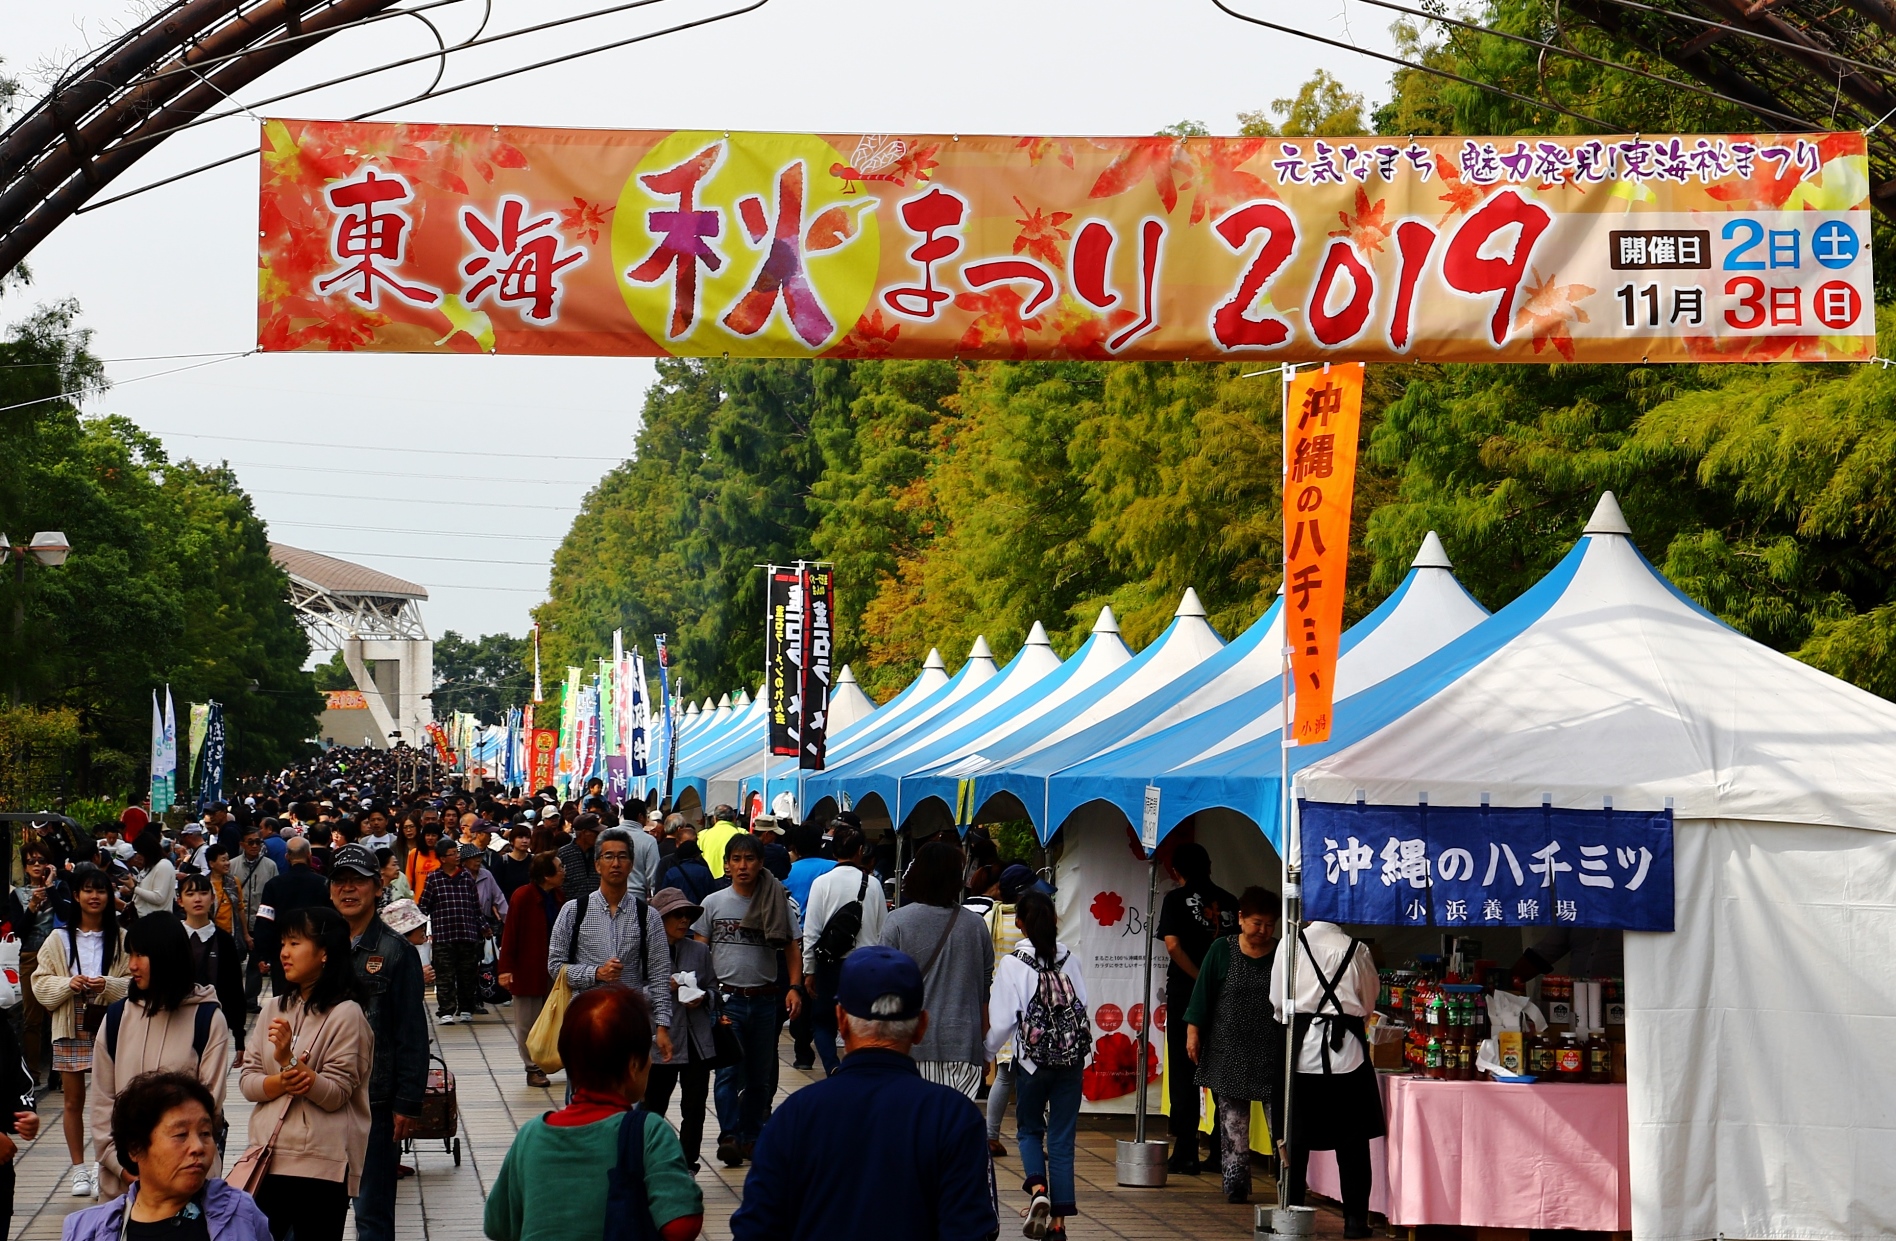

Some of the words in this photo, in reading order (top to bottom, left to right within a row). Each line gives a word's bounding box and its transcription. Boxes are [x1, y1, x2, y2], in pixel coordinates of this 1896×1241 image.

[1273, 142, 1435, 185] 元気なまち
[1619, 235, 1702, 266] 開催日
[1323, 836, 1653, 891] 沖縄のハチミツ
[1406, 898, 1578, 922] 小浜養蜂場
